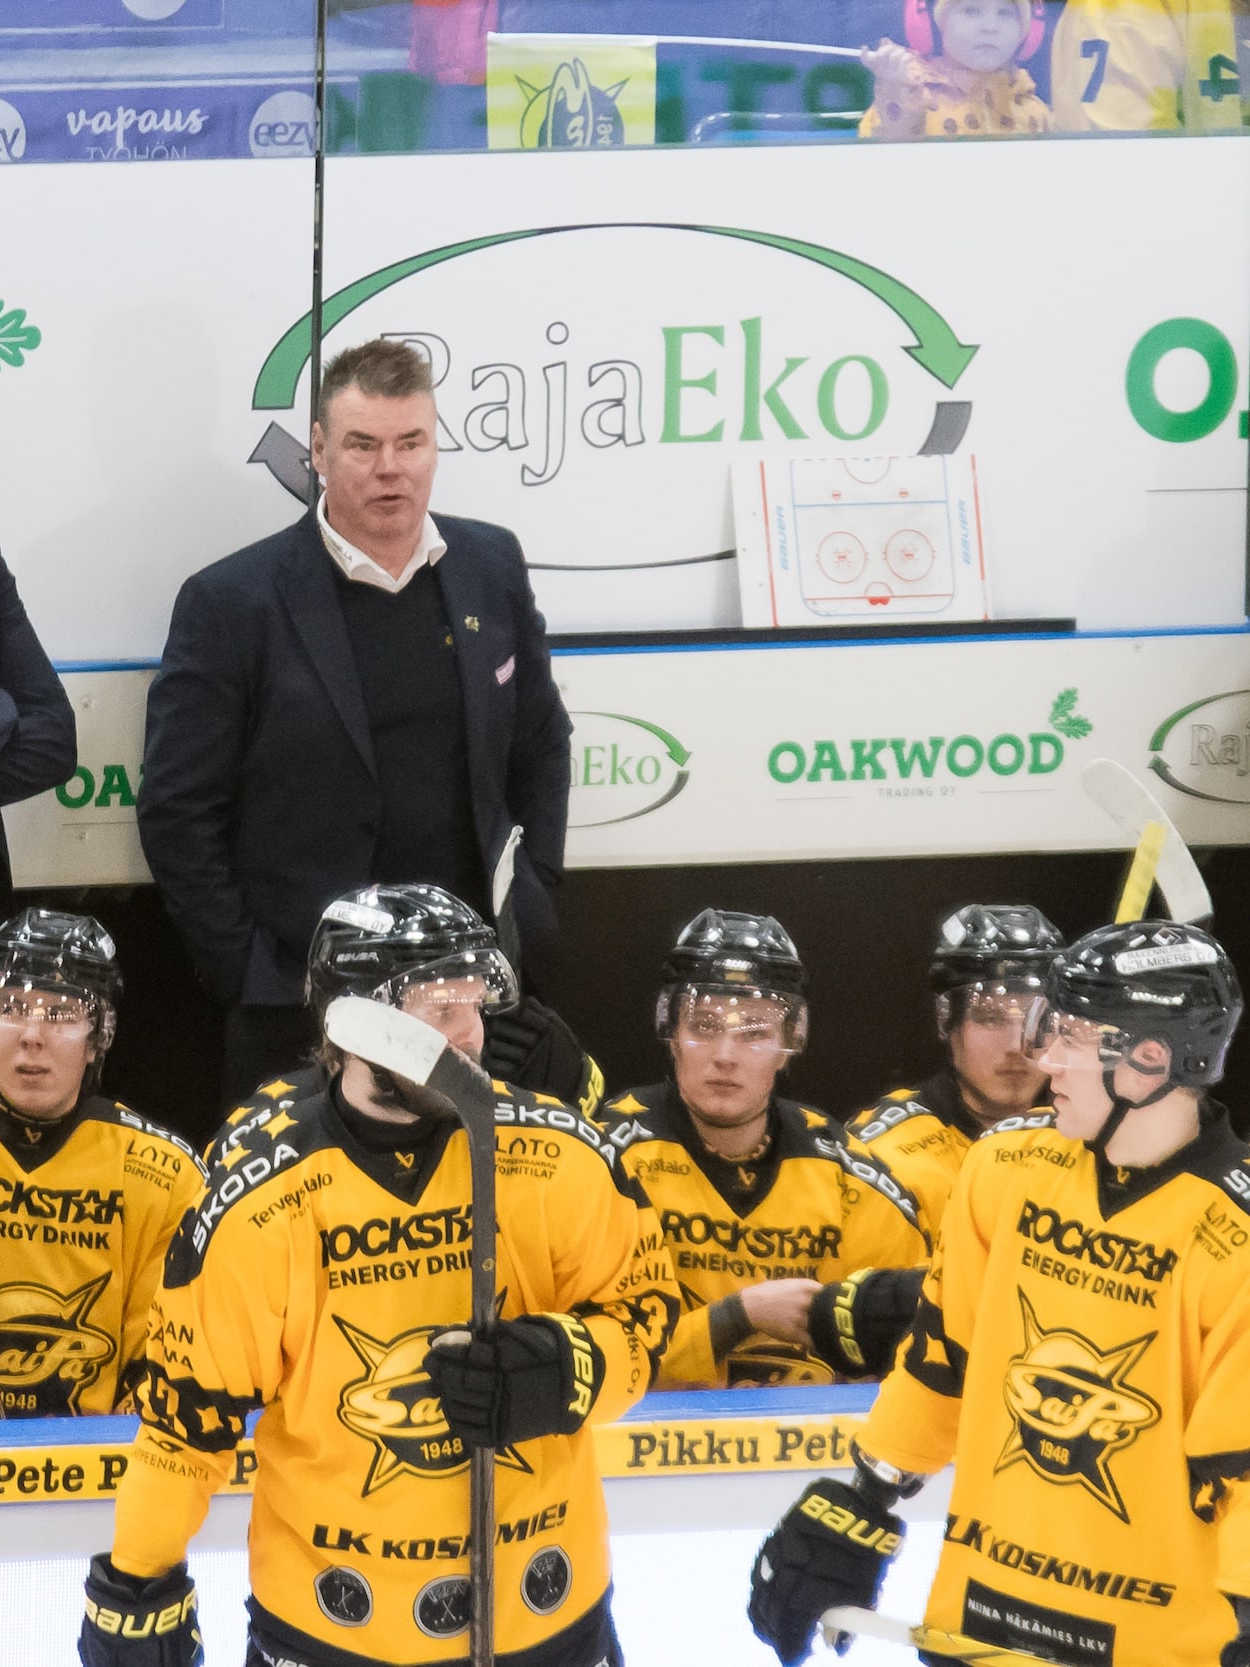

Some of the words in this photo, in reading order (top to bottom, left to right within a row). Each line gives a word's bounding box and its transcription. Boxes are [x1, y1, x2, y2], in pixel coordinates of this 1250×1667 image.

[1079, 39, 1110, 103] 7
[67, 105, 210, 149] vapaus
[767, 732, 1064, 783] OAKWOOD
[878, 786, 934, 798] TRADING
[494, 1135, 561, 1158] LATO
[248, 1172, 333, 1229] Terveystalo
[42, 1224, 111, 1250] DRINK
[660, 1208, 843, 1259] ROCKSTAR
[1016, 1198, 1181, 1283] ROCKSTAR
[329, 1259, 421, 1290] ENERGY
[1091, 1274, 1157, 1309] DRINK
[420, 1437, 463, 1462] 1948
[627, 1429, 762, 1468] Pikku
[1039, 1438, 1071, 1466] 1948
[987, 1535, 1177, 1607] KOSKIMIES
[1078, 1635, 1108, 1652] LKV
